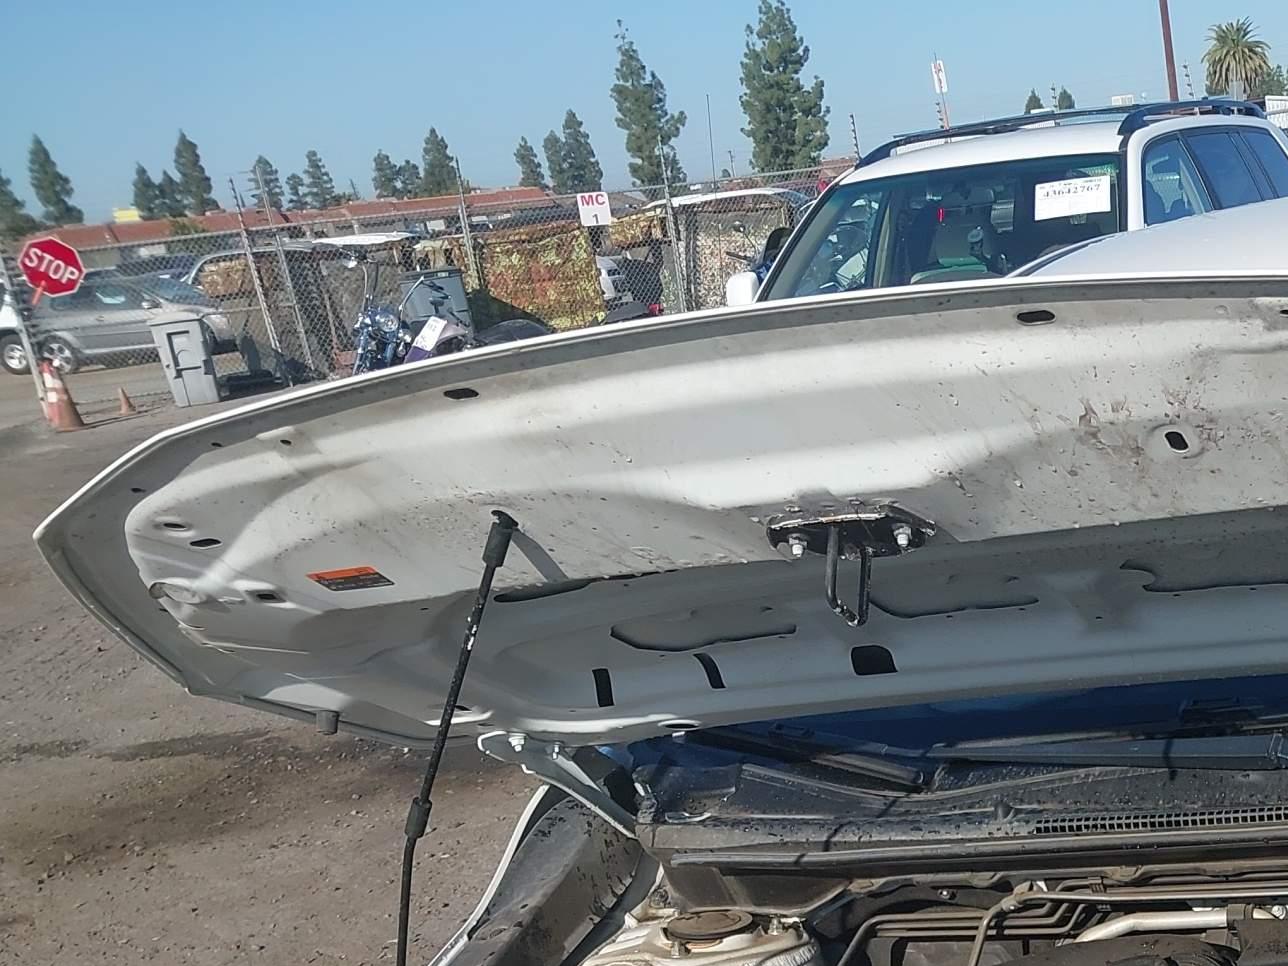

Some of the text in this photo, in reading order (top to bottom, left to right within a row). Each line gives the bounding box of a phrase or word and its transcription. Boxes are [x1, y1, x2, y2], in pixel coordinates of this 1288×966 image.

[580, 193, 606, 207] MC
[592, 213, 600, 225] 1
[24, 247, 80, 285] STOP
